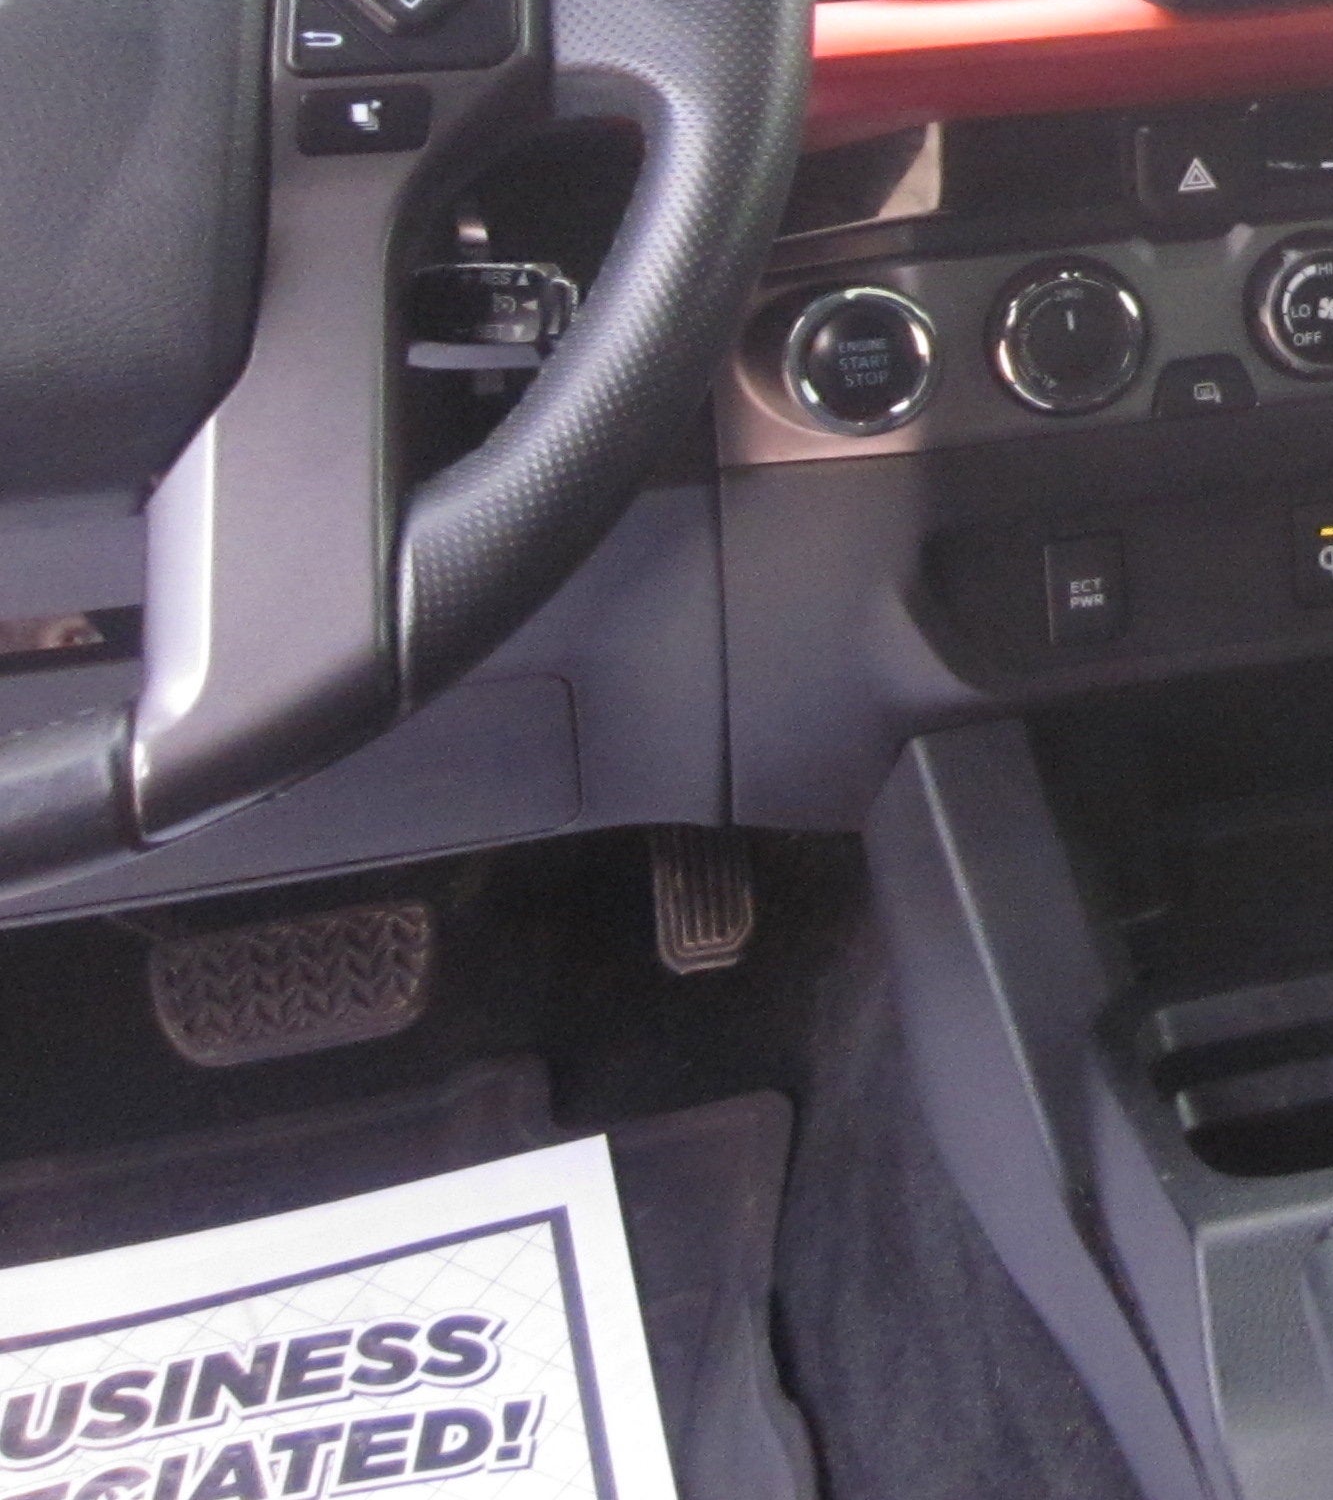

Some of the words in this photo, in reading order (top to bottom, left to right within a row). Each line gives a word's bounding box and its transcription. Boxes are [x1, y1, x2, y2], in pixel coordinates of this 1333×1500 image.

[1317, 262, 1333, 276] HI
[1290, 303, 1311, 318] LO
[1293, 331, 1323, 347] OFF
[839, 354, 888, 371] START
[844, 371, 889, 388] STOP
